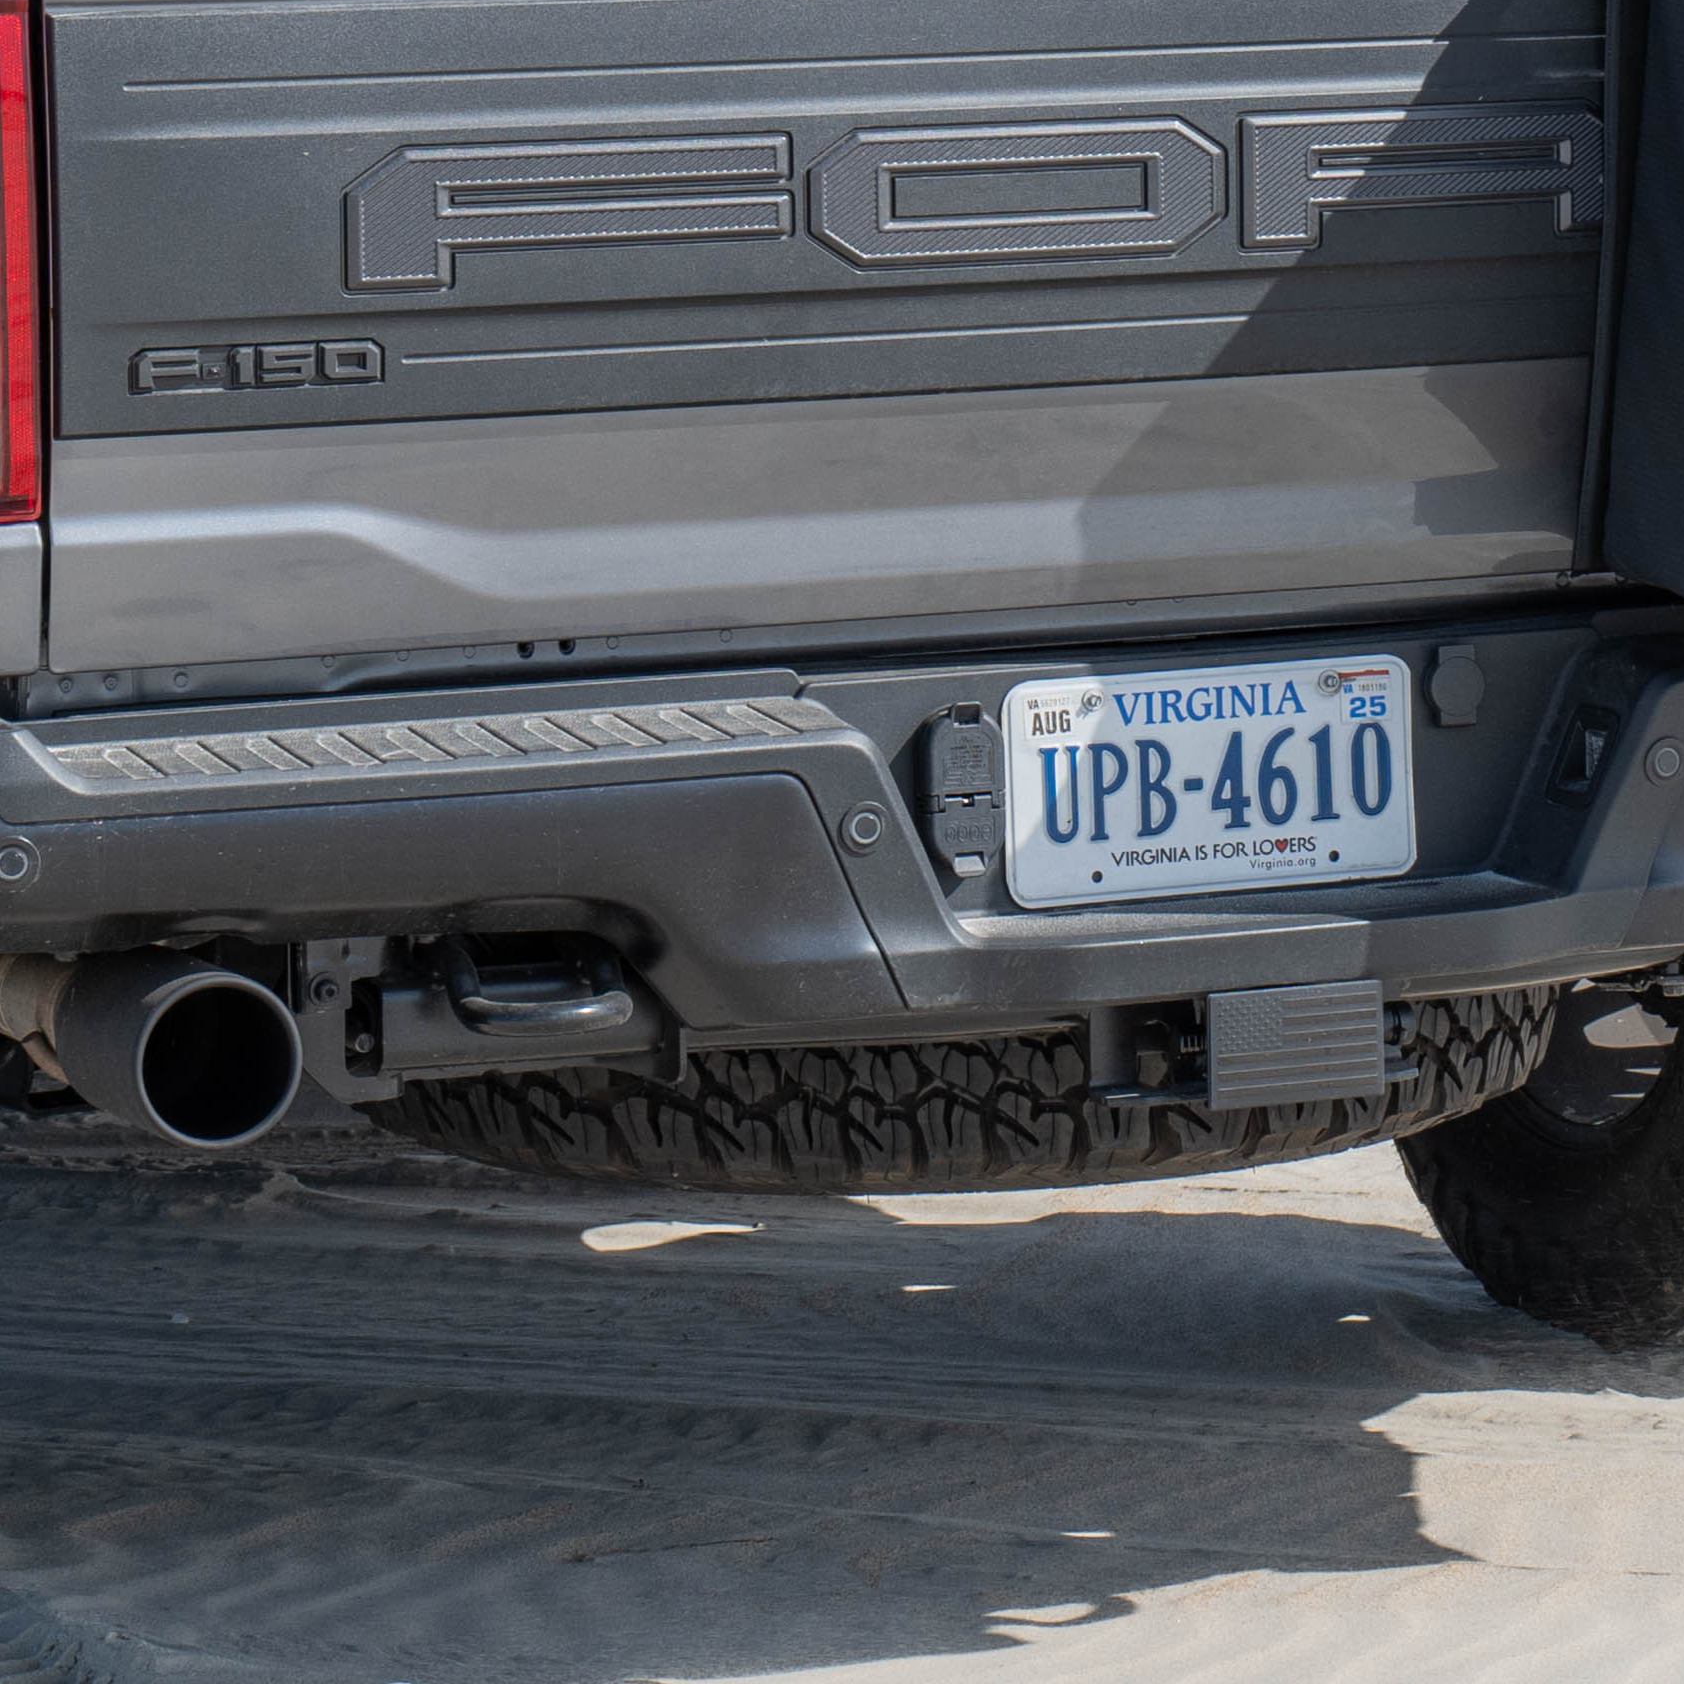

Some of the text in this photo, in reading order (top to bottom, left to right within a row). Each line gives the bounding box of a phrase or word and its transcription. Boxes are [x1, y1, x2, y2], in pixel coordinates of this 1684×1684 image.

[1342, 683, 1354, 694] VA
[1027, 699, 1039, 710] VA
[1111, 679, 1307, 727] VIRGINIA
[1349, 695, 1387, 718] 25
[1032, 709, 1071, 736] AUG
[1038, 721, 1392, 844] UPB-4610
[1111, 846, 1191, 867] VIRGINIA
[1195, 845, 1208, 861] IS
[1213, 842, 1249, 859] FOR
[1249, 857, 1316, 871] Virginia.org
